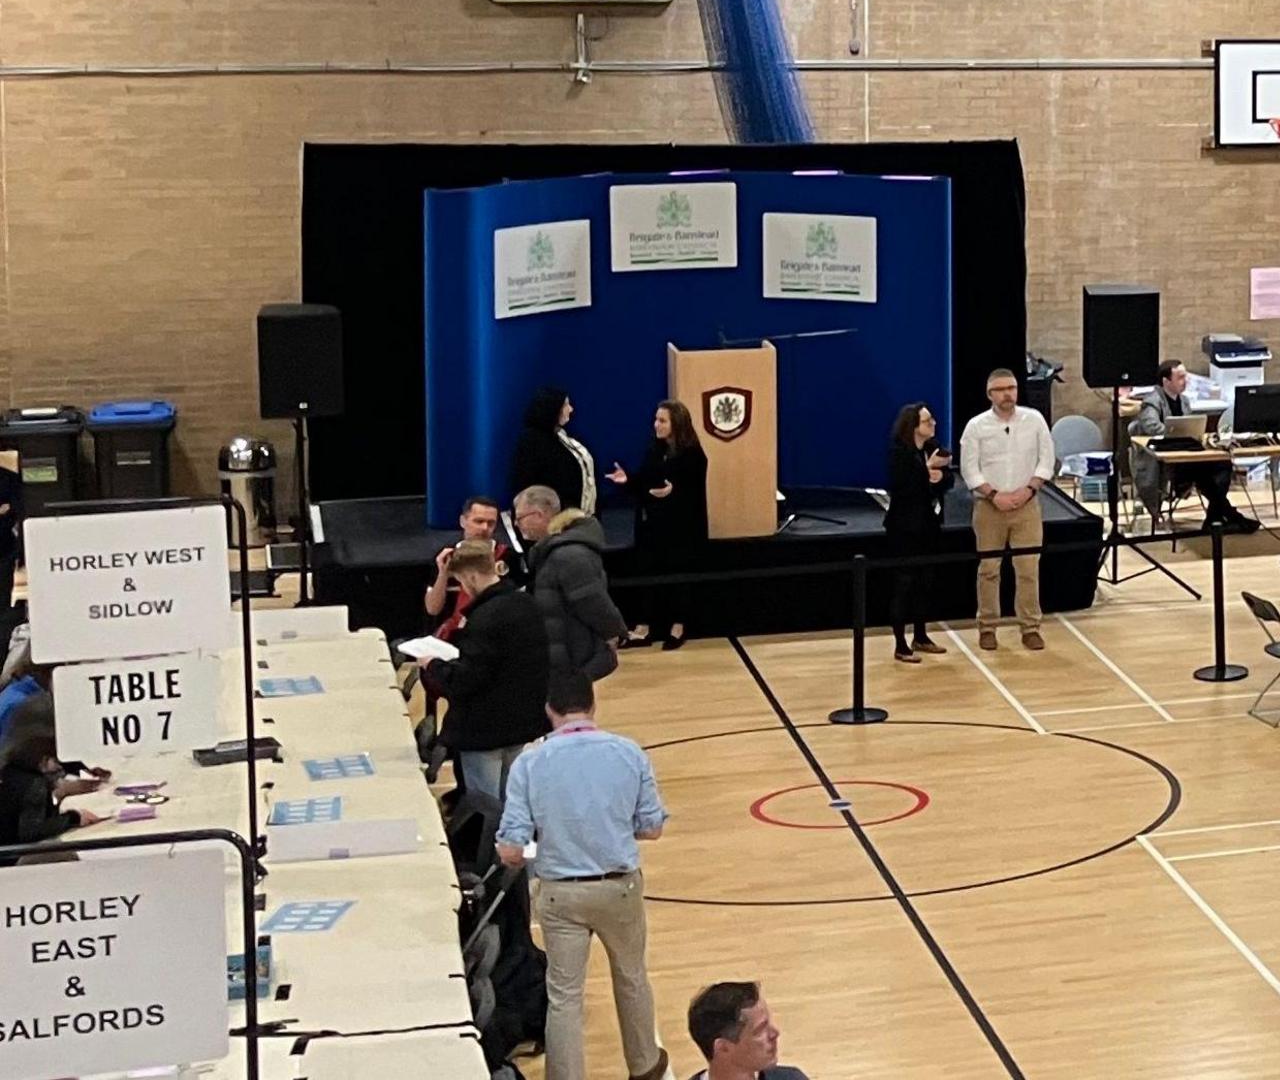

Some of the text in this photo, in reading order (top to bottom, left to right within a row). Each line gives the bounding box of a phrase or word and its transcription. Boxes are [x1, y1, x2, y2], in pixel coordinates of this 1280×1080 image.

[49, 546, 205, 572] HORLEY WEST
[122, 577, 137, 592] &
[88, 599, 173, 620] SIDLOW
[88, 669, 182, 705] TABLE
[101, 710, 173, 746] NO 7
[5, 894, 141, 928] HORLEY
[31, 934, 118, 964] EAST
[64, 975, 86, 998] &
